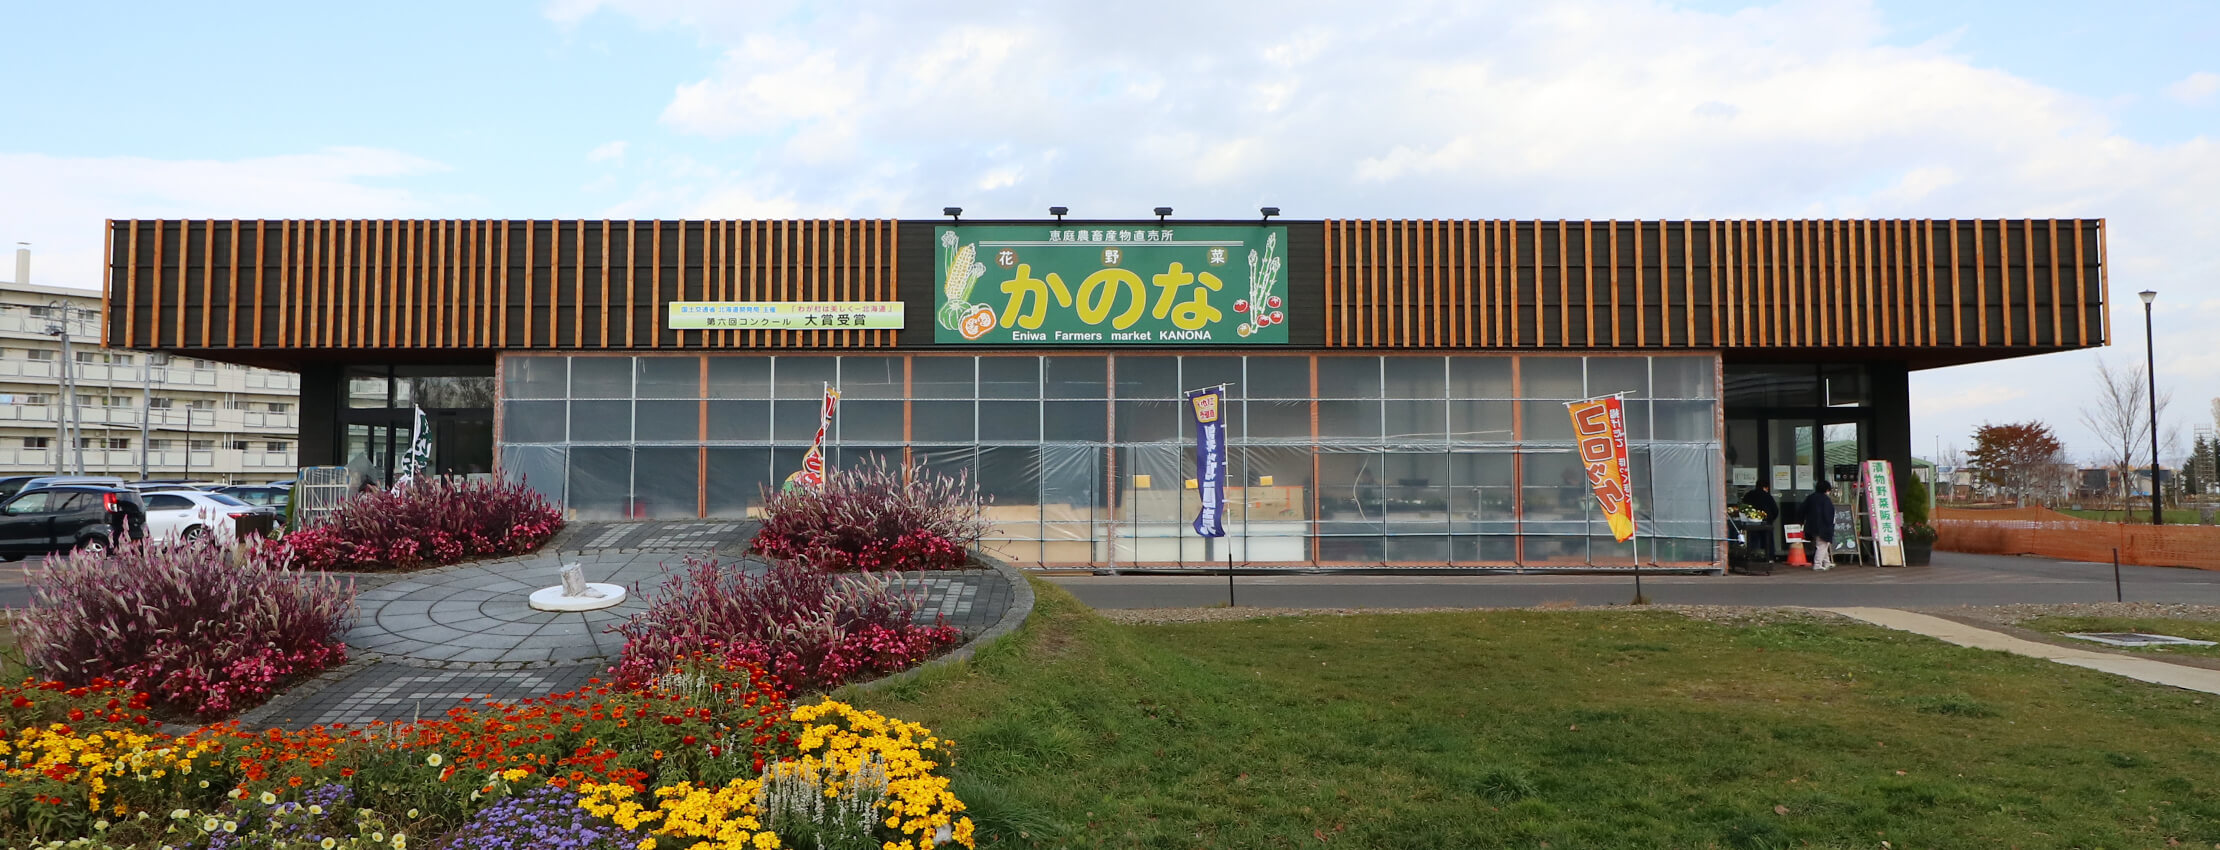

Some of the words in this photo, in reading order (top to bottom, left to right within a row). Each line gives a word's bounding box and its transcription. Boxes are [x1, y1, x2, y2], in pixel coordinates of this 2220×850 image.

[1049, 230, 1174, 243] 恵庭農畜産物直売所
[999, 251, 1014, 266] 花
[1104, 249, 1120, 264] 野
[1210, 248, 1225, 264] 菜
[999, 262, 1223, 331] かのな
[707, 318, 791, 326] 第六回コンクール
[805, 314, 866, 326] 大賞受賞
[1012, 331, 1047, 341] Eniwa
[1055, 331, 1102, 341] Farmers
[1111, 331, 1151, 342] market
[1159, 331, 1212, 341] KANONA
[1871, 462, 1894, 545] 漬物野菜販売中
